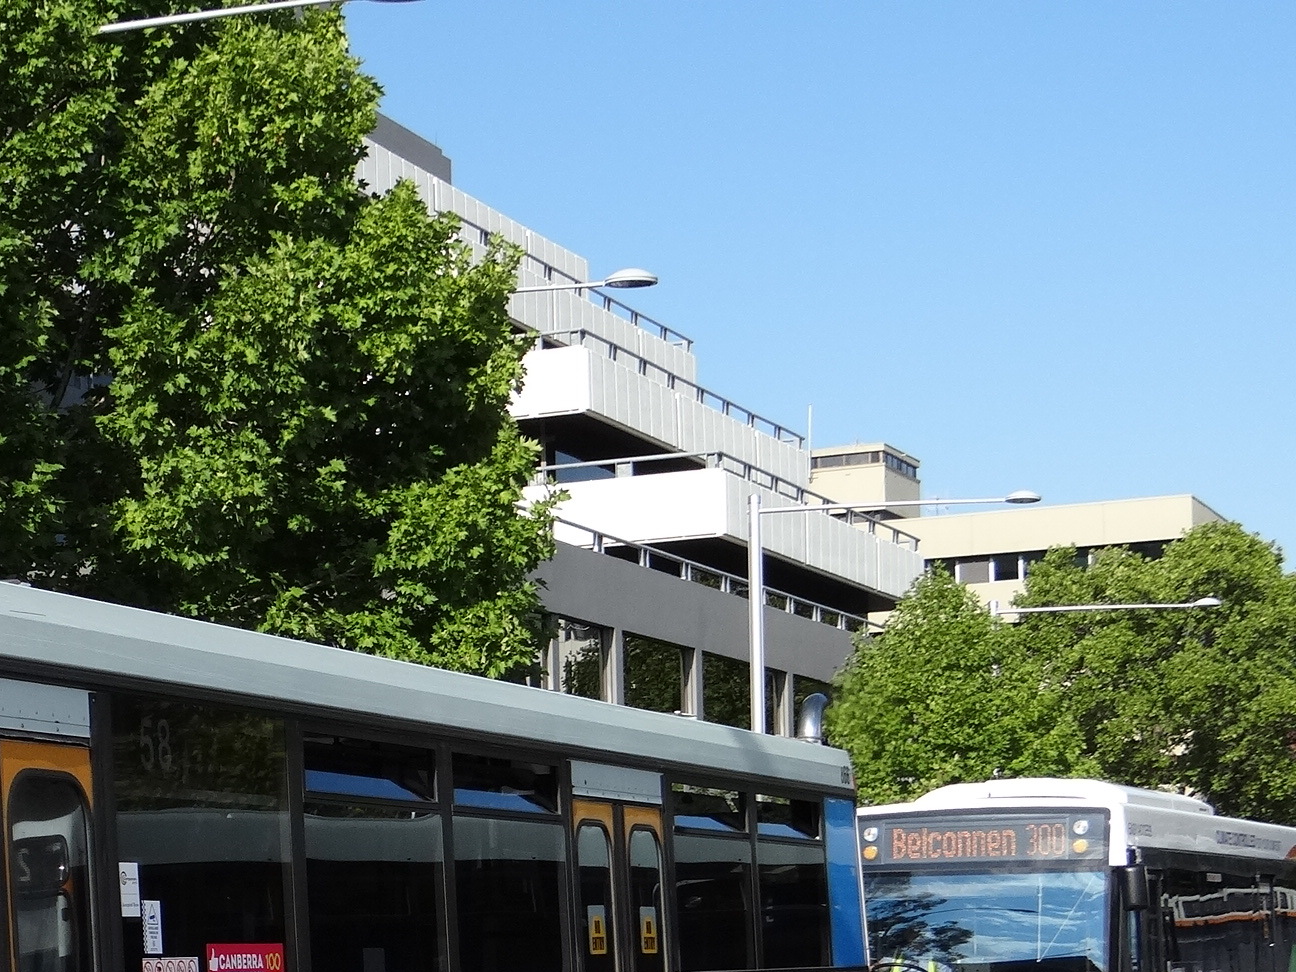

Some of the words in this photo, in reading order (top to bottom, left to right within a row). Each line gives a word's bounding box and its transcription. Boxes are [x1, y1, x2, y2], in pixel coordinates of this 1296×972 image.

[892, 827, 1016, 860] Belconnen
[1026, 823, 1065, 856] 300
[219, 954, 264, 970] CANBERRA
[265, 952, 281, 970] 100
